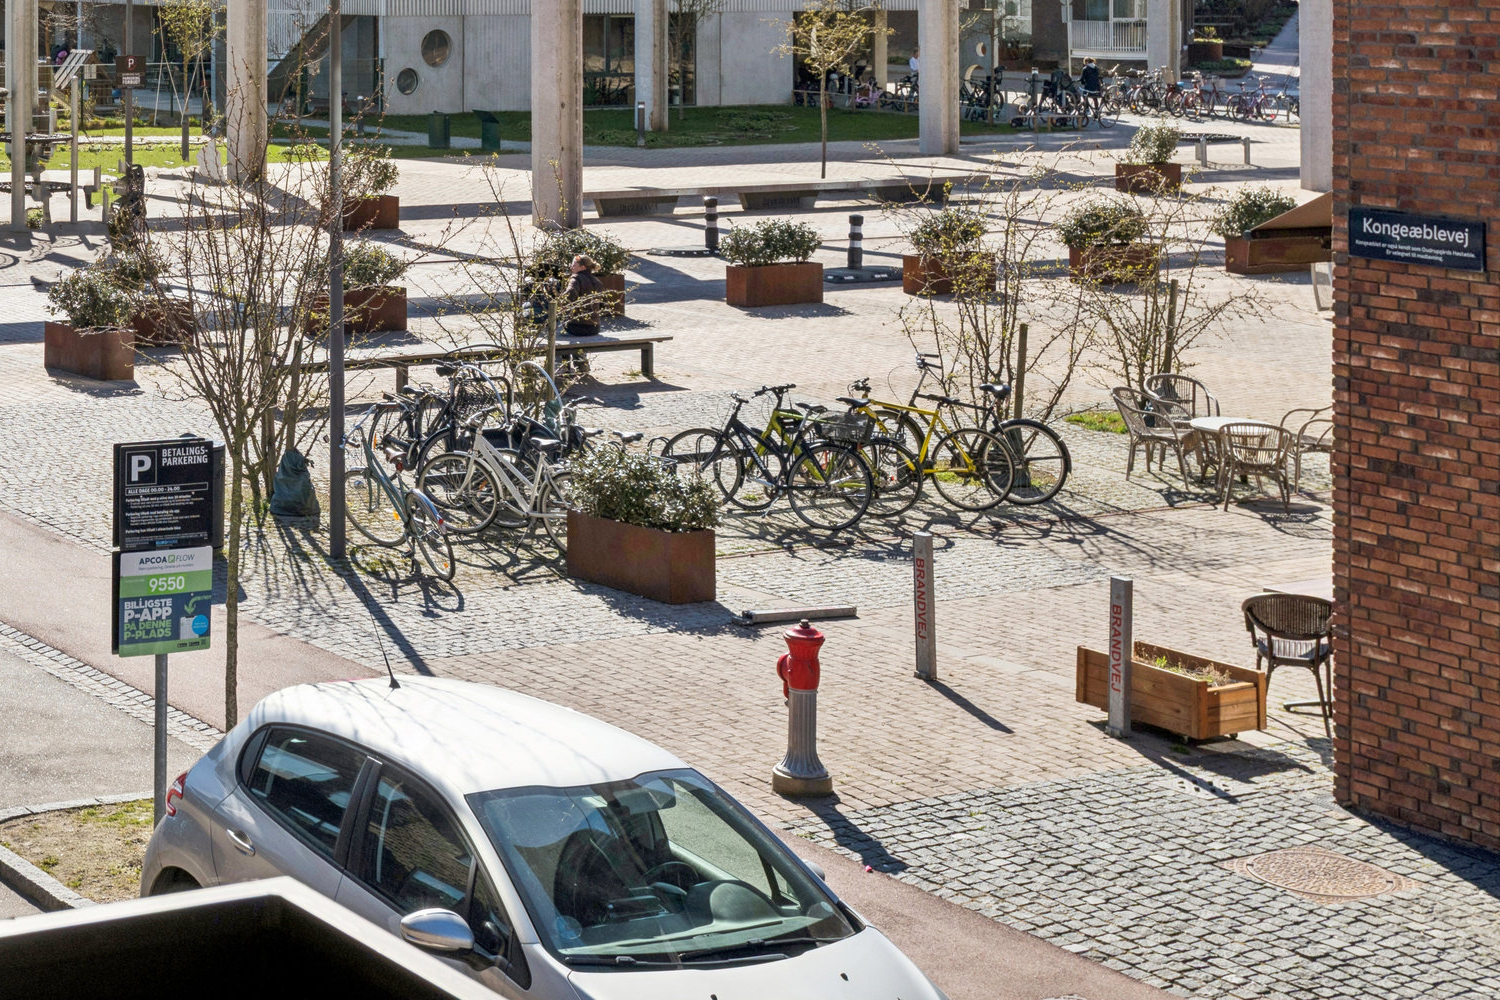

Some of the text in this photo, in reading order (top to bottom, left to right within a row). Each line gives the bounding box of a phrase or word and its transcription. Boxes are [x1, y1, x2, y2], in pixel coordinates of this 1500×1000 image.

[128, 58, 135, 68] P
[1363, 217, 1469, 248] Kongeæblevej
[162, 446, 208, 457] BETALINGS-
[162, 455, 208, 467] PARKERING
[131, 455, 152, 482] P
[139, 556, 167, 565] APCOA
[176, 554, 195, 562] FLOW
[149, 576, 185, 592] 9550
[124, 598, 172, 610] BILLIGSTE
[916, 558, 926, 640] BRANDVEJ
[124, 607, 172, 623] P-APP
[124, 620, 172, 631] PÅ DENNE
[124, 628, 171, 641] P-PLADS
[1111, 604, 1121, 693] BRANDVEJ
